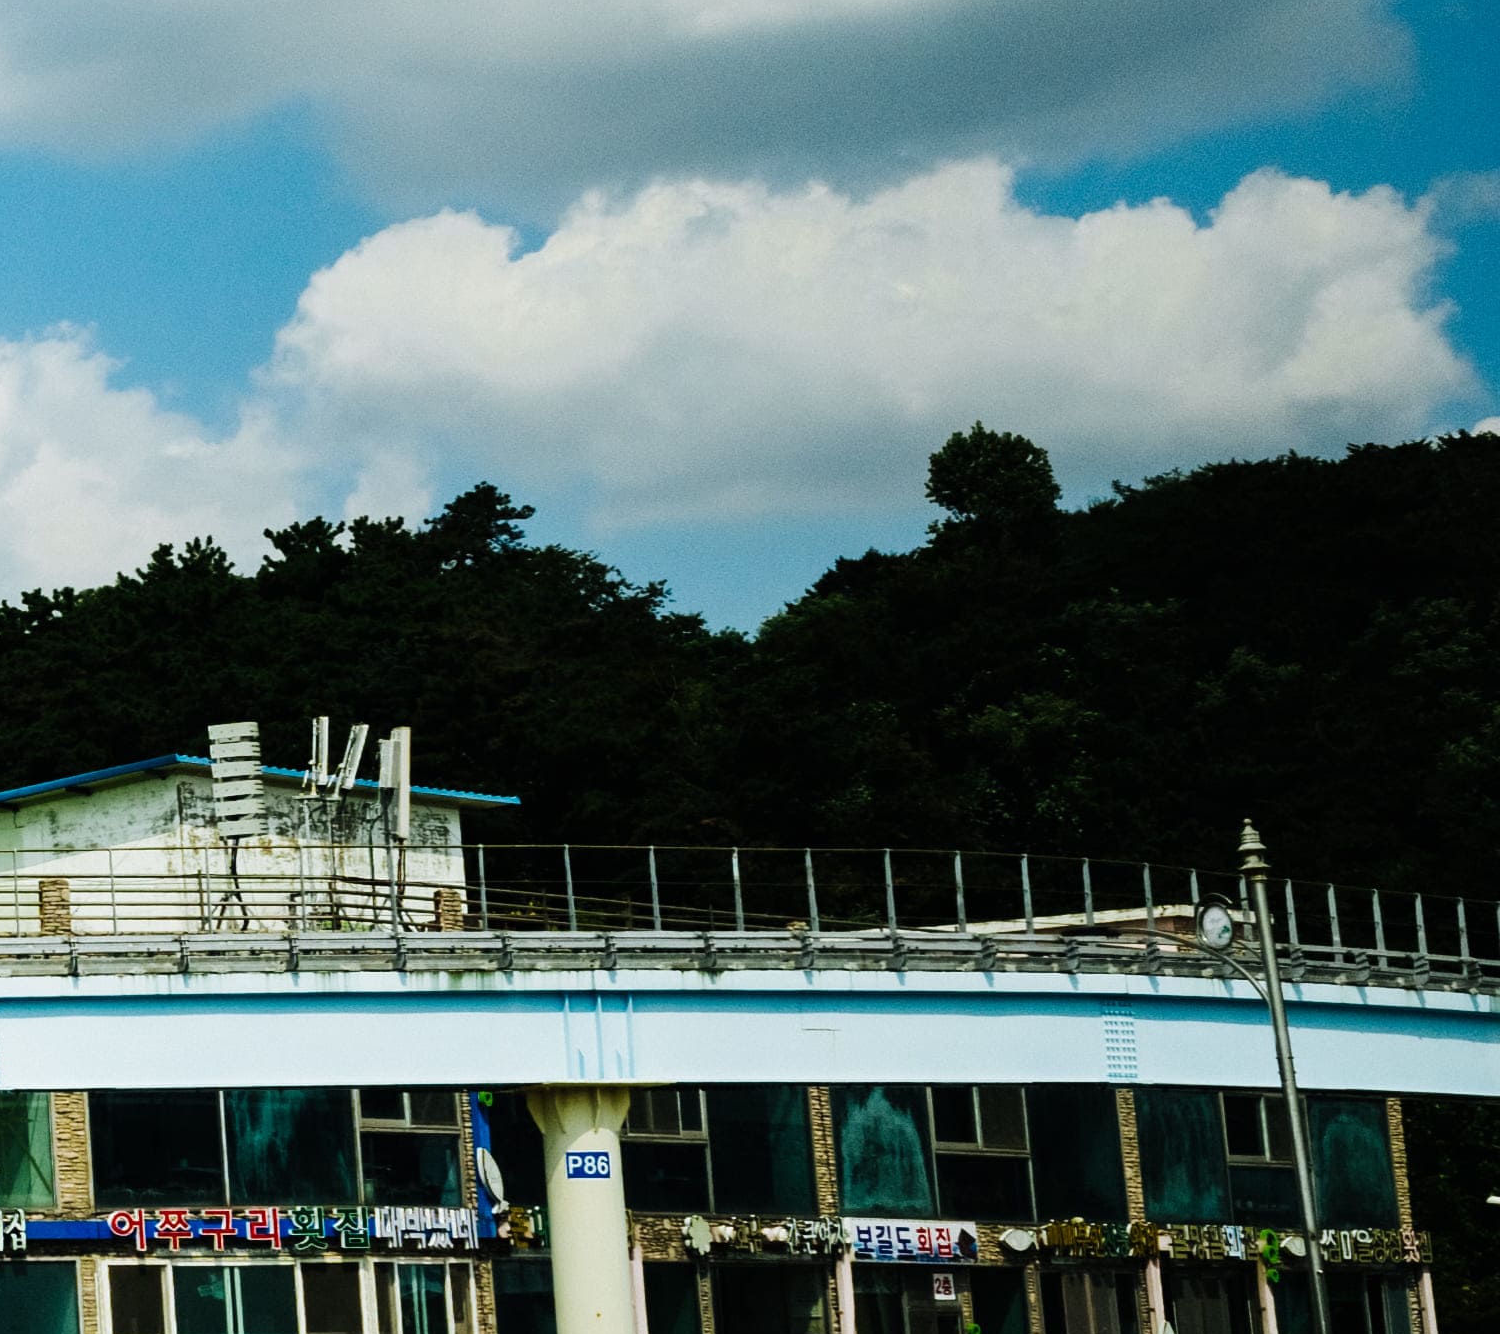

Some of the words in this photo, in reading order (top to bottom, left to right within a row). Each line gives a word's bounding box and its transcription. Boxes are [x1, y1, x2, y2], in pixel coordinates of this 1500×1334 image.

[568, 1155, 609, 1176] P86
[107, 1207, 282, 1252] 어쭈구리
[289, 1205, 370, 1251] 횟집
[856, 1225, 914, 1256] 보길도
[916, 1227, 954, 1257] 회집
[935, 1276, 952, 1295] 2층
